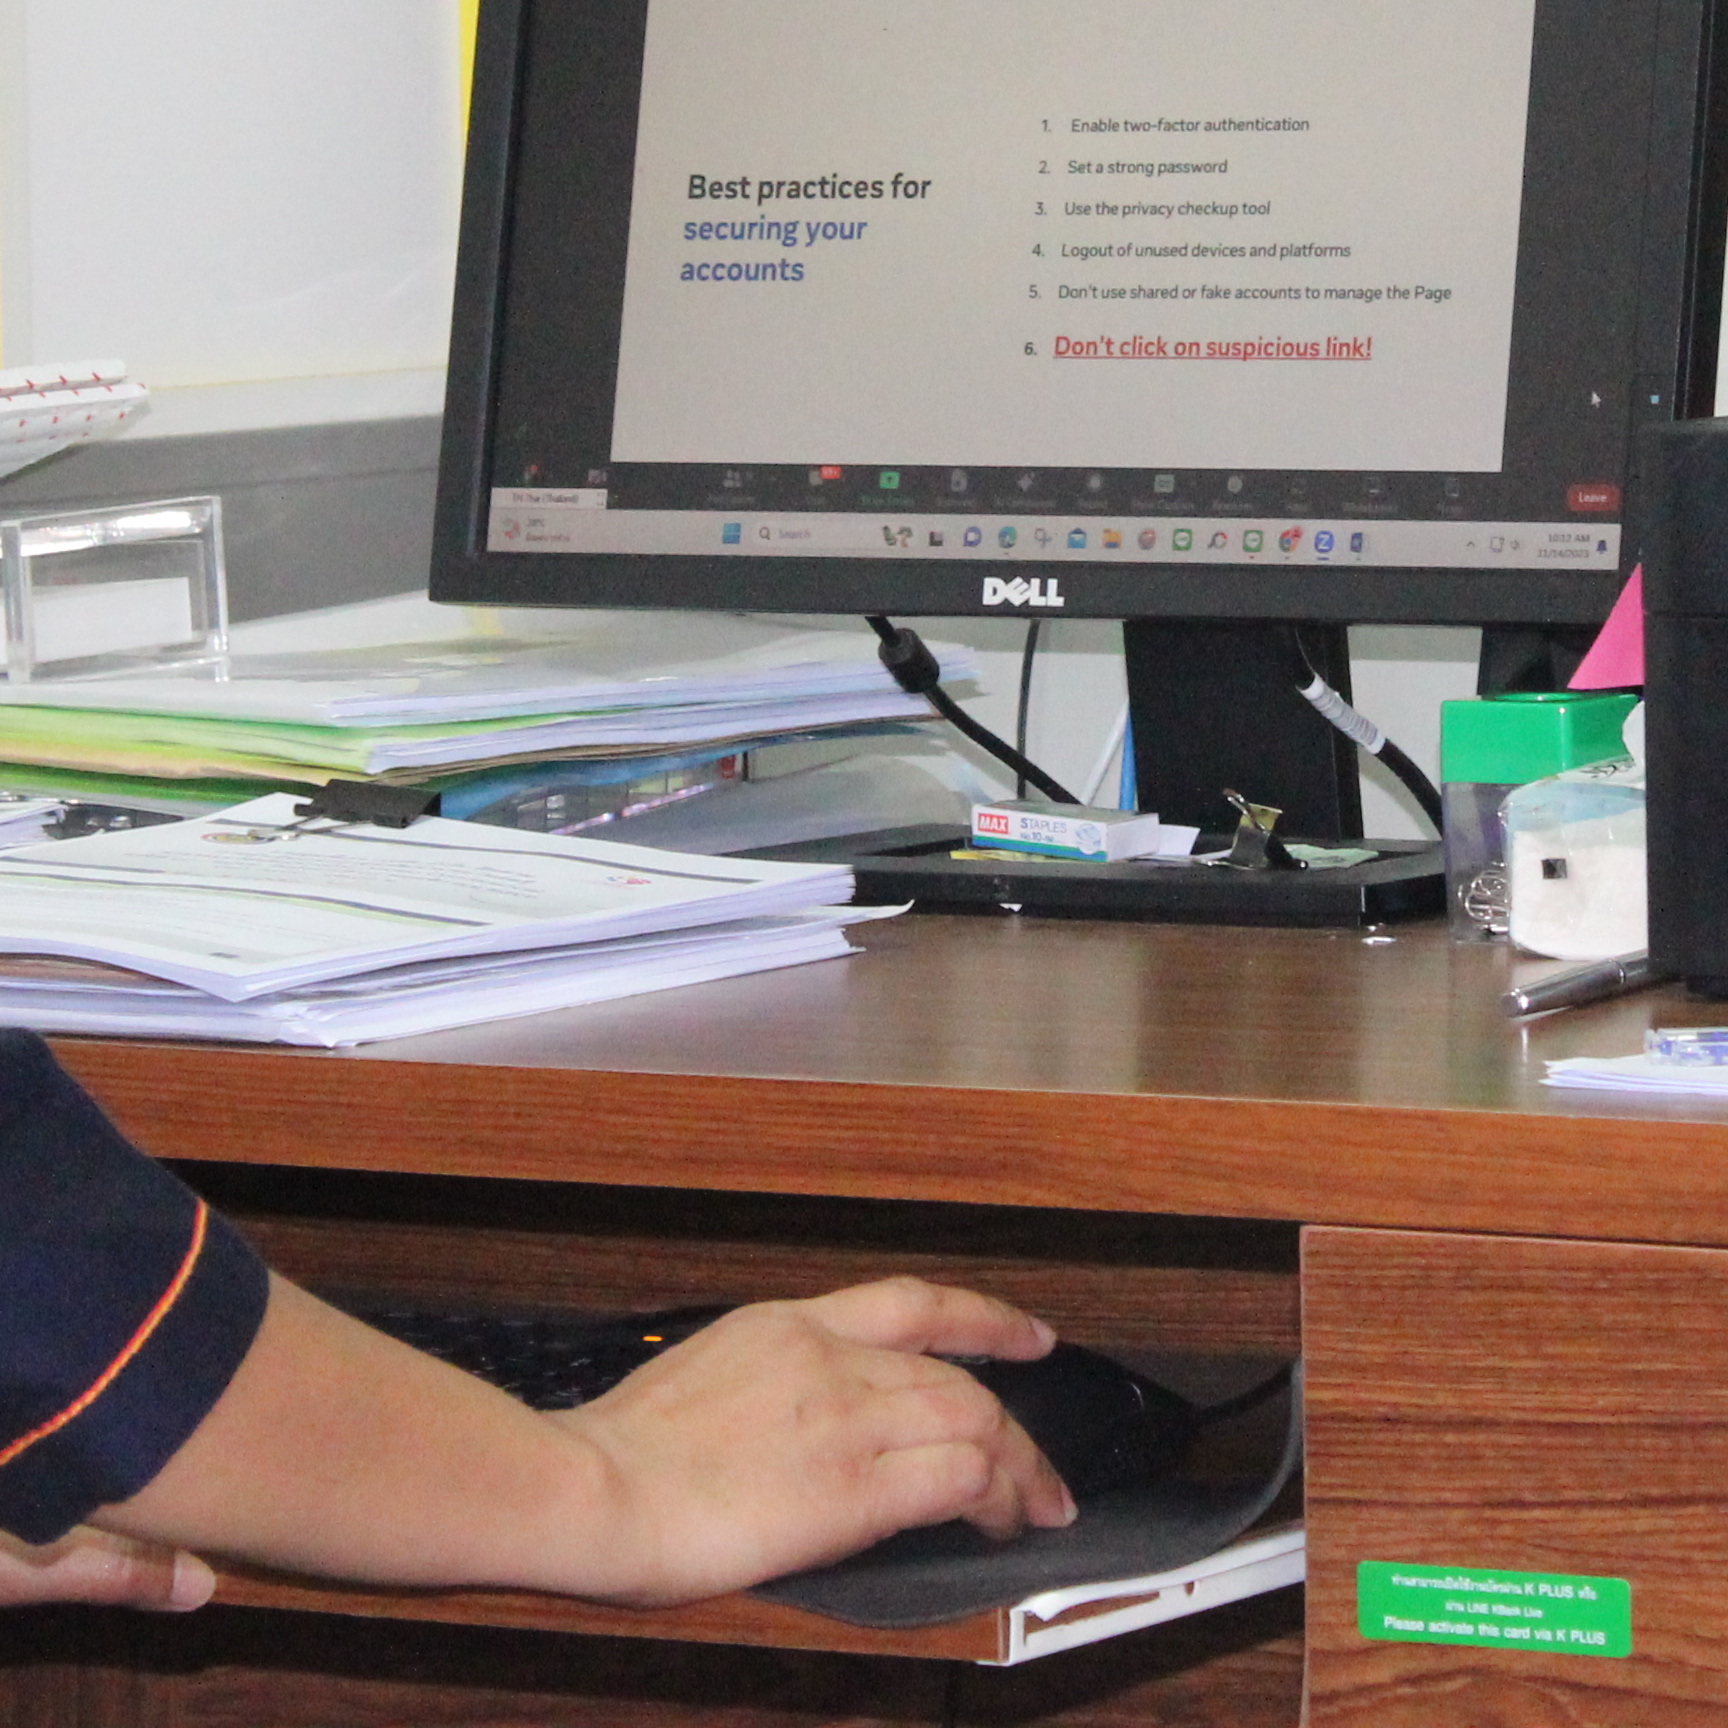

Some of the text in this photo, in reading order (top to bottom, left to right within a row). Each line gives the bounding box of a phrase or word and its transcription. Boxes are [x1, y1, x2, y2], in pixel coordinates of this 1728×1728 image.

[1071, 118, 1120, 133] Enable
[1124, 118, 1201, 133] two-factor
[1204, 117, 1310, 133] authentication
[1038, 159, 1229, 179] 2. Set a strong password
[688, 173, 933, 207] Best practices for
[1035, 201, 1271, 220] 3. Use the privacy checkup tool
[683, 214, 869, 248] securing your
[1032, 243, 1352, 262] 4. Logout of unused devices and platforms
[679, 258, 805, 283] accounts
[1029, 285, 1453, 305] 5. Don't use shared or fake accounts to manage the Page
[1025, 336, 1373, 364] 6. Don't click on suspicious link!
[1578, 490, 1608, 504] Leave
[983, 577, 1065, 608] DELL
[980, 815, 1008, 832] MAX
[1020, 817, 1068, 834] STAPLES
[1523, 1583, 1536, 1596] K
[1538, 1584, 1574, 1599] PLUS
[1467, 1602, 1490, 1616] LINE
[1524, 1607, 1544, 1620] Live
[1383, 1616, 1607, 1647] Please activate this card via K PLUS
